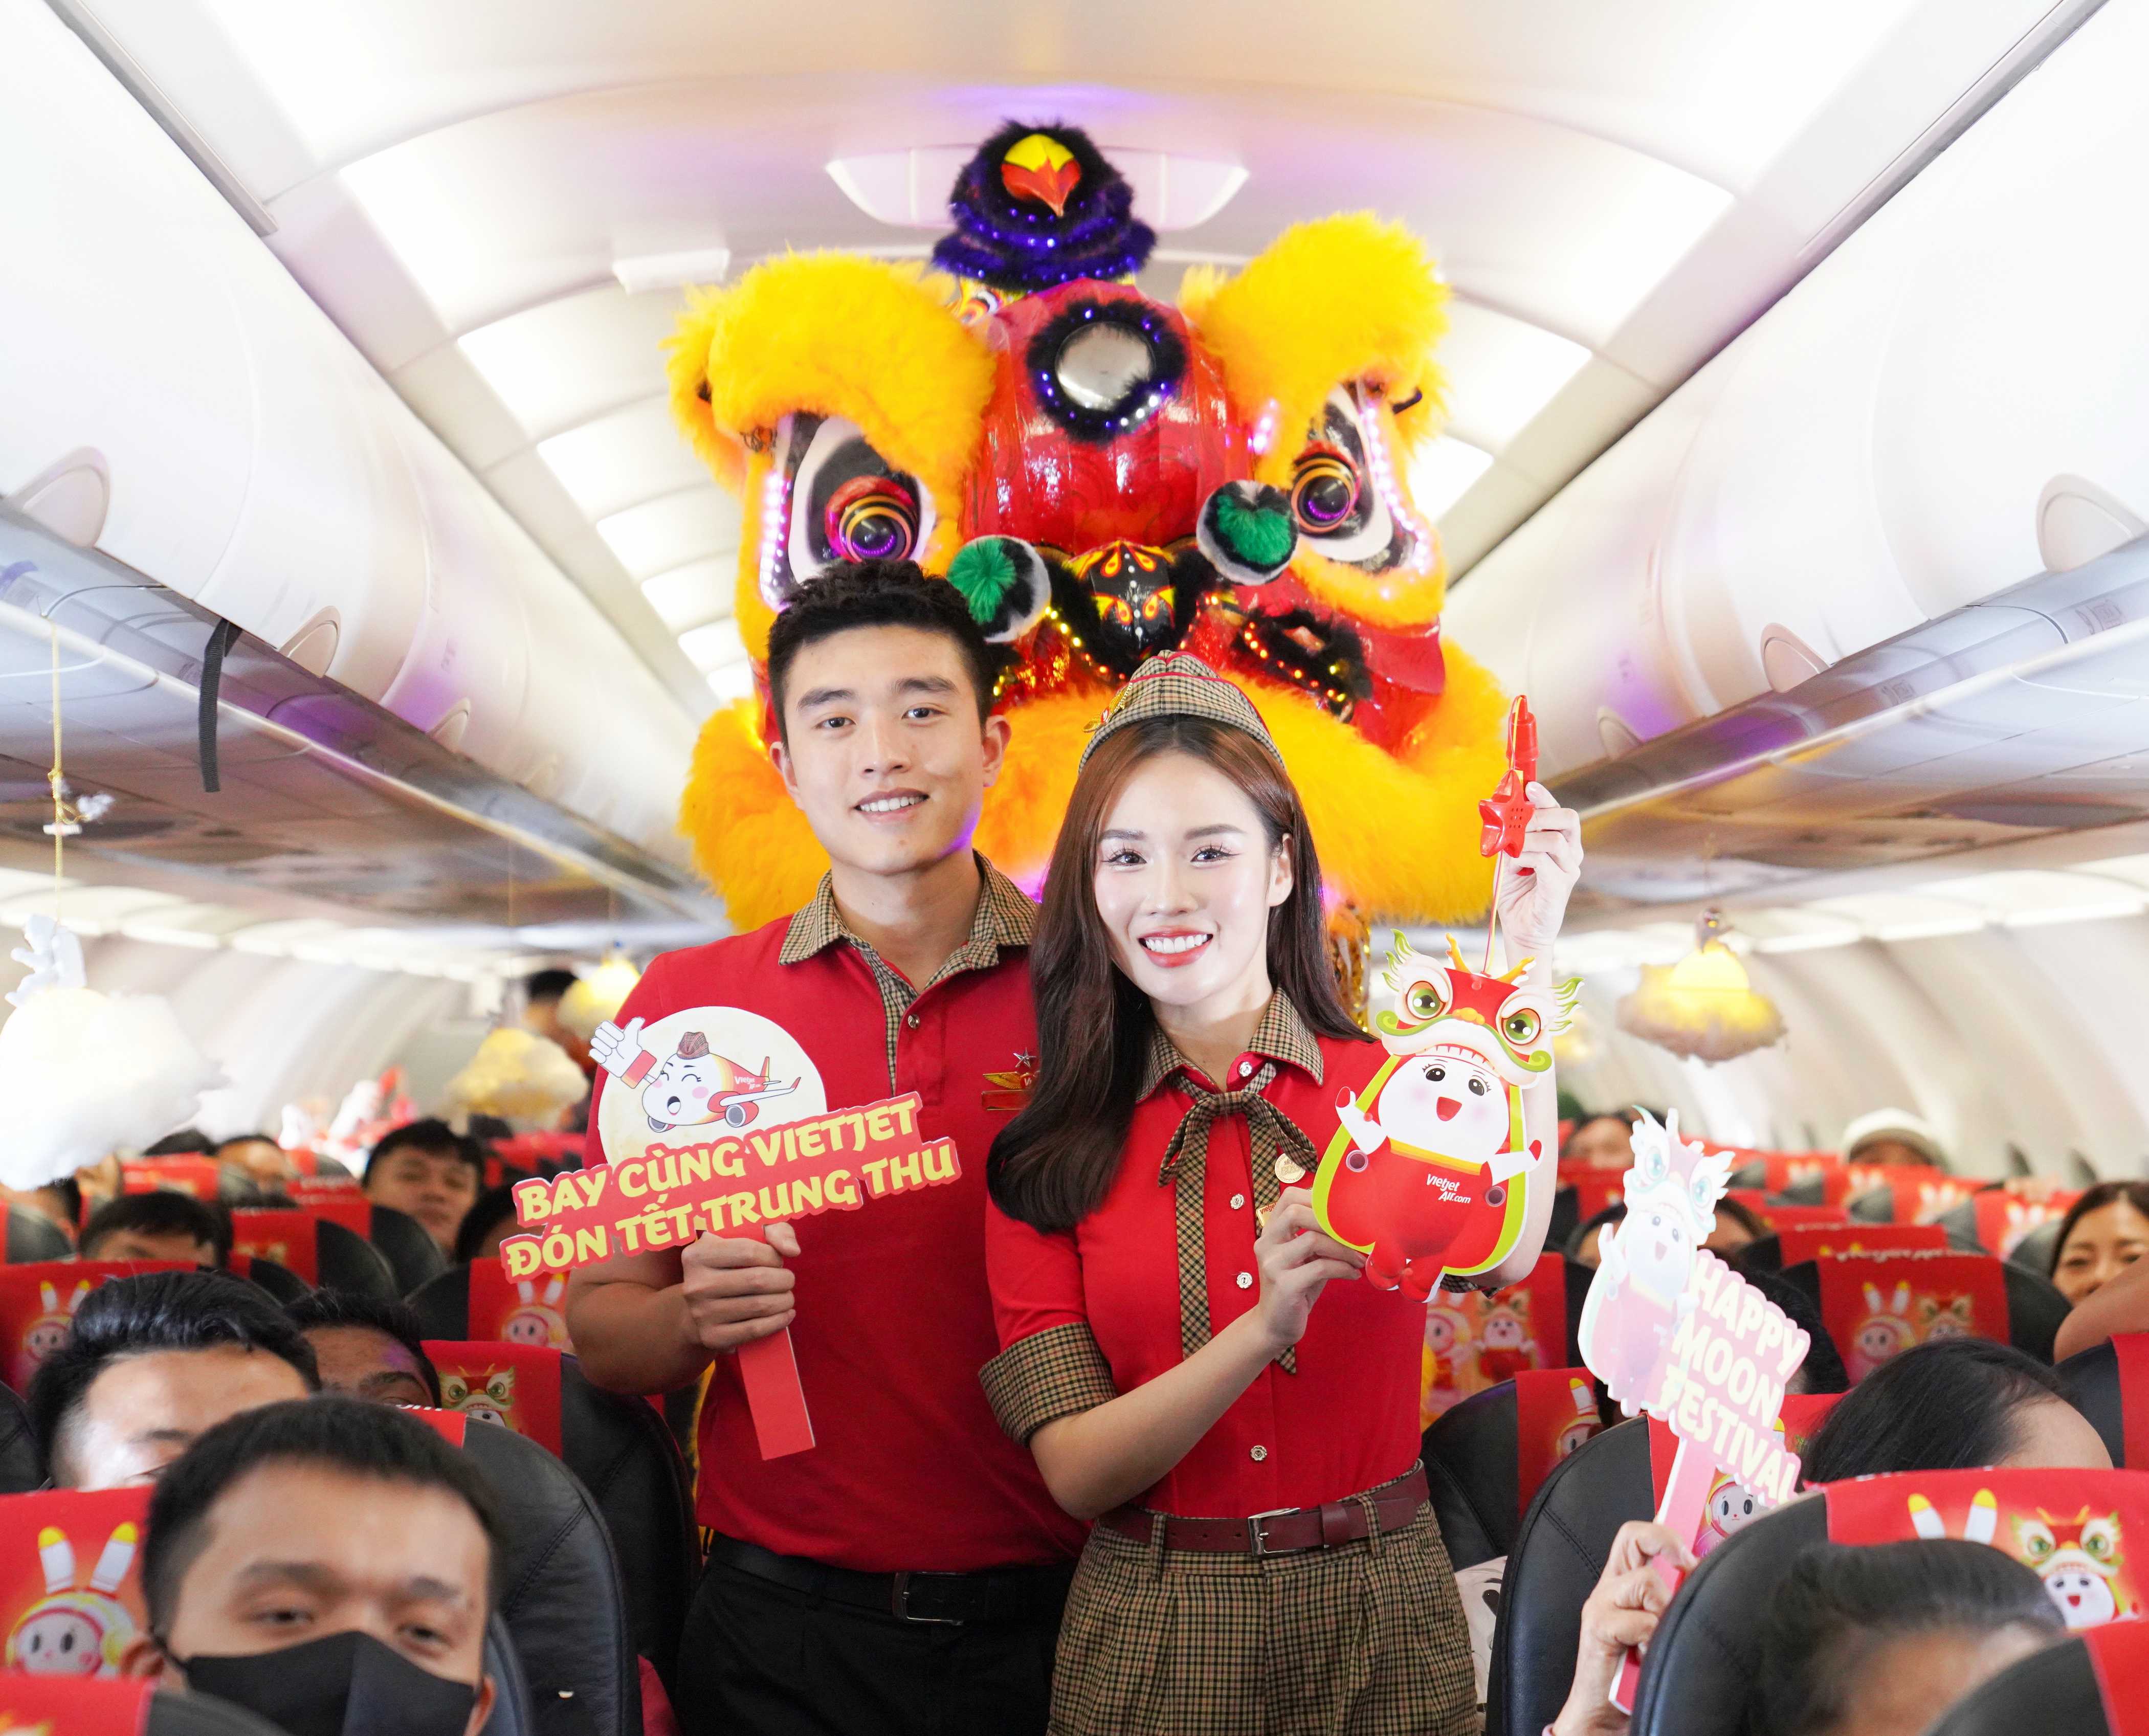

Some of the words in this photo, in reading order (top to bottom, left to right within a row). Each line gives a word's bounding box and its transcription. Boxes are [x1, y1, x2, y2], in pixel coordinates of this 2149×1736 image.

[506, 1225, 607, 1276] ĐÓN
[615, 1194, 693, 1251] TẾT
[701, 1169, 857, 1231] TRUNG
[862, 1145, 955, 1194] THU
[518, 1171, 607, 1221] BAY
[619, 1150, 745, 1197] CÙNG
[750, 1099, 916, 1166] VIETJET
[1426, 1173, 1460, 1192] Vietjet
[1438, 1190, 1471, 1204] Air.com
[1671, 1313, 1782, 1428] MOON
[1688, 1256, 1806, 1376] HAPPY
[1658, 1363, 1797, 1505] FESTIVAL
